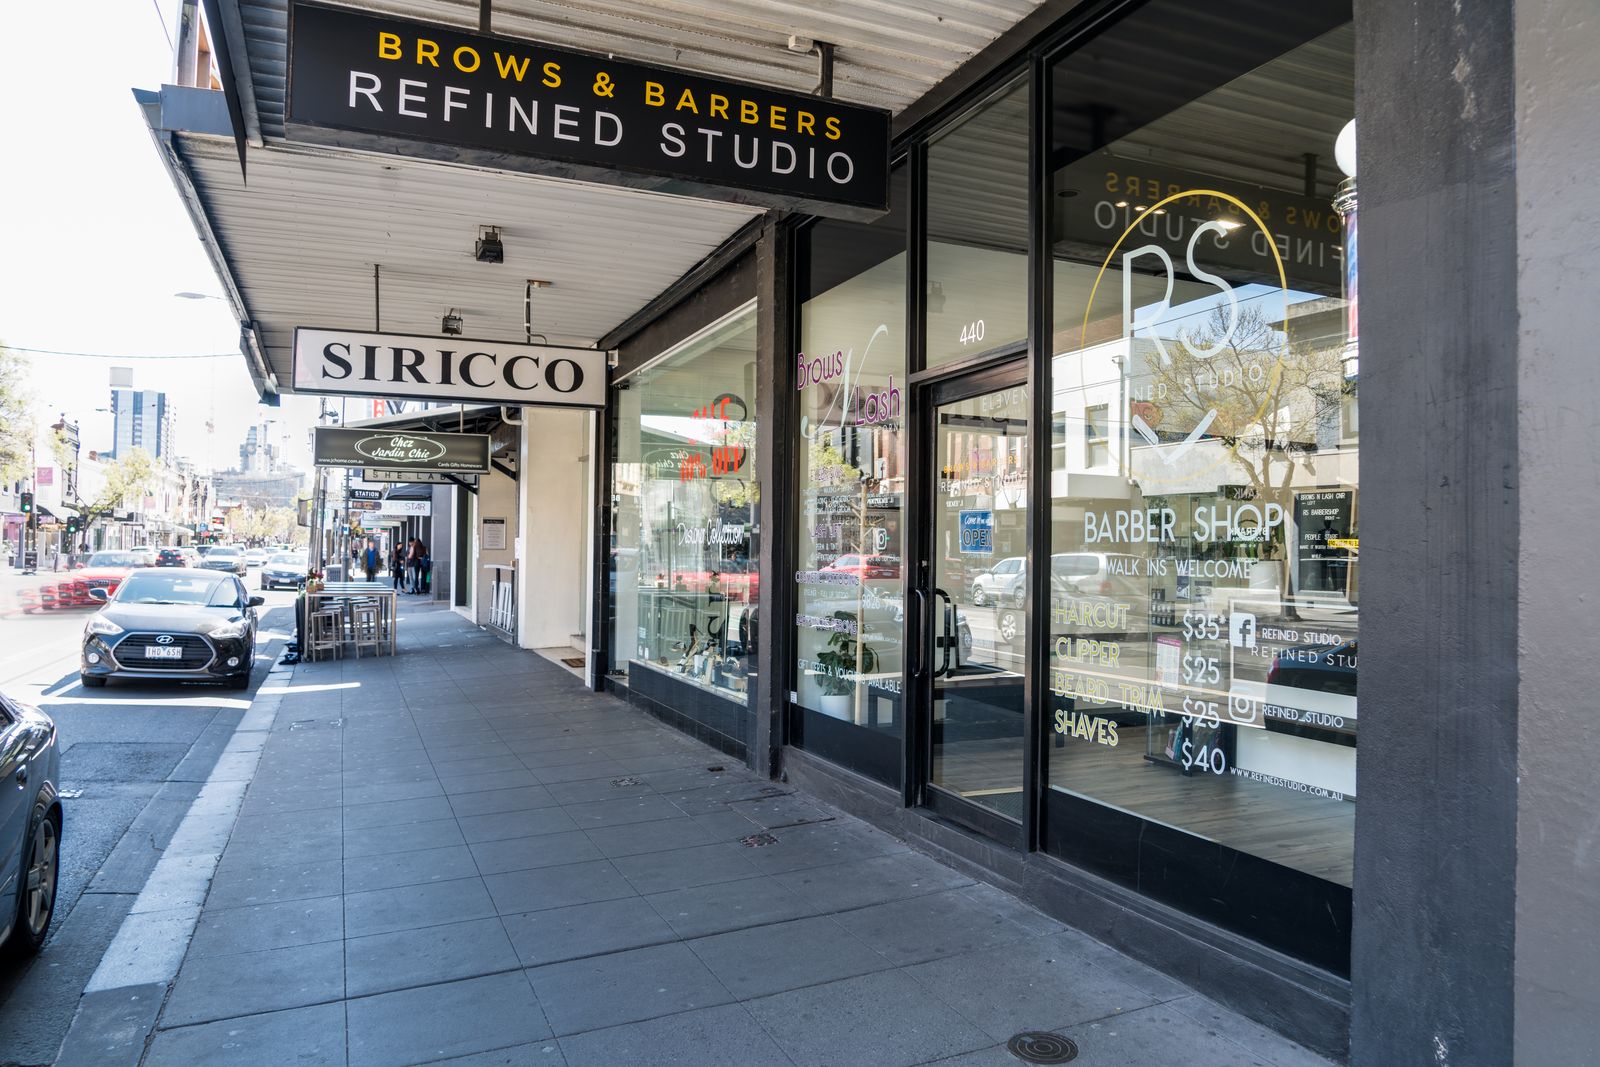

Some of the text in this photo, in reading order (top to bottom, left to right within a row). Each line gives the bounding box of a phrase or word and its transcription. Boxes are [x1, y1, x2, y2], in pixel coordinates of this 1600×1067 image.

[378, 32, 842, 140] BROWS & BARBERS
[349, 70, 855, 185] REFINED STUDIO
[960, 319, 985, 345] 440
[321, 342, 585, 393] SIRICCO
[1184, 364, 1262, 394] STUDIO
[797, 350, 842, 390] Brows
[855, 375, 901, 426] Lash
[372, 447, 430, 459] Jardin Chic
[390, 436, 414, 448] Chez
[355, 490, 380, 498] STATION
[1084, 503, 1283, 543] BARBER SHOP
[1310, 508, 1340, 516] BARBERSHOP
[706, 517, 744, 546] Collection
[1304, 533, 1322, 541] PEOPLE
[1106, 559, 1251, 579] WALK INS WELCOME
[1054, 600, 1130, 630] HAIRCUT
[1262, 628, 1299, 642] REFINED
[1303, 631, 1341, 646] STUDIO
[1055, 637, 1220, 685] CLIPPER $25
[1251, 644, 1357, 668] REFINED STU
[868, 676, 901, 694] AVAILABLE
[1055, 672, 1220, 729] BEARD TRIM $25
[1262, 704, 1344, 729] REFINED_STUDIO
[1054, 710, 1226, 775] SHAVES $40
[1230, 766, 1343, 801] WWW.REFINEDSTUDIO.COM.AU
